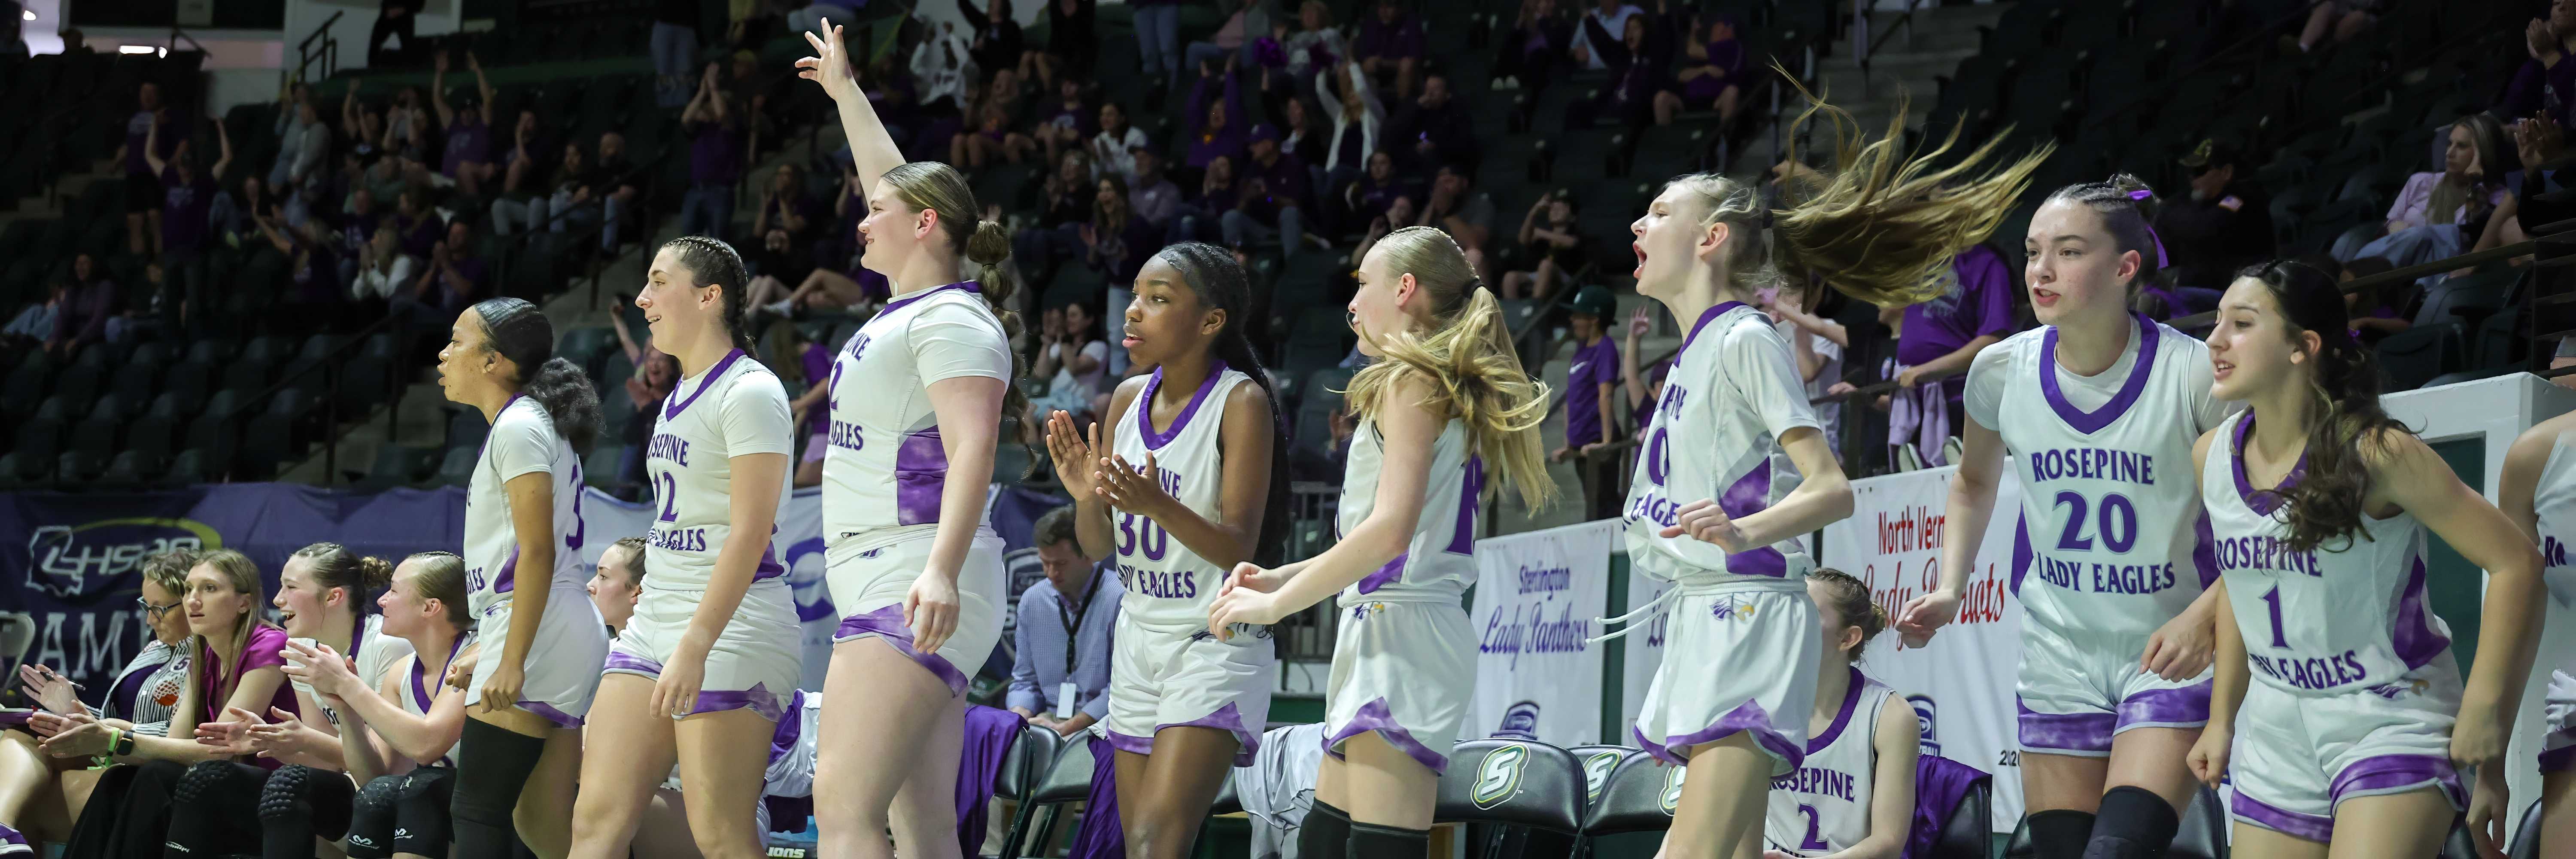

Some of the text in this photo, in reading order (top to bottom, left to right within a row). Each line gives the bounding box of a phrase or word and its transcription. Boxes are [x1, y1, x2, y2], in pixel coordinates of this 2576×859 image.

[647, 433, 690, 468] OSEPINE
[2031, 448, 2155, 485] ROSEPINE
[1116, 510, 1168, 563] 30
[1878, 506, 1913, 555] North
[2052, 489, 2139, 555] 20
[2037, 551, 2175, 594] LADY EAGLES
[2215, 536, 2323, 578] ROSEPINE
[1138, 570, 1196, 598] EAGLES
[1519, 560, 1571, 600] Sterlington
[1479, 602, 1589, 671] Lady Panthers
[2258, 579, 2293, 651] 1
[2278, 649, 2366, 690] EAGLES
[1797, 802, 1829, 852] 2
